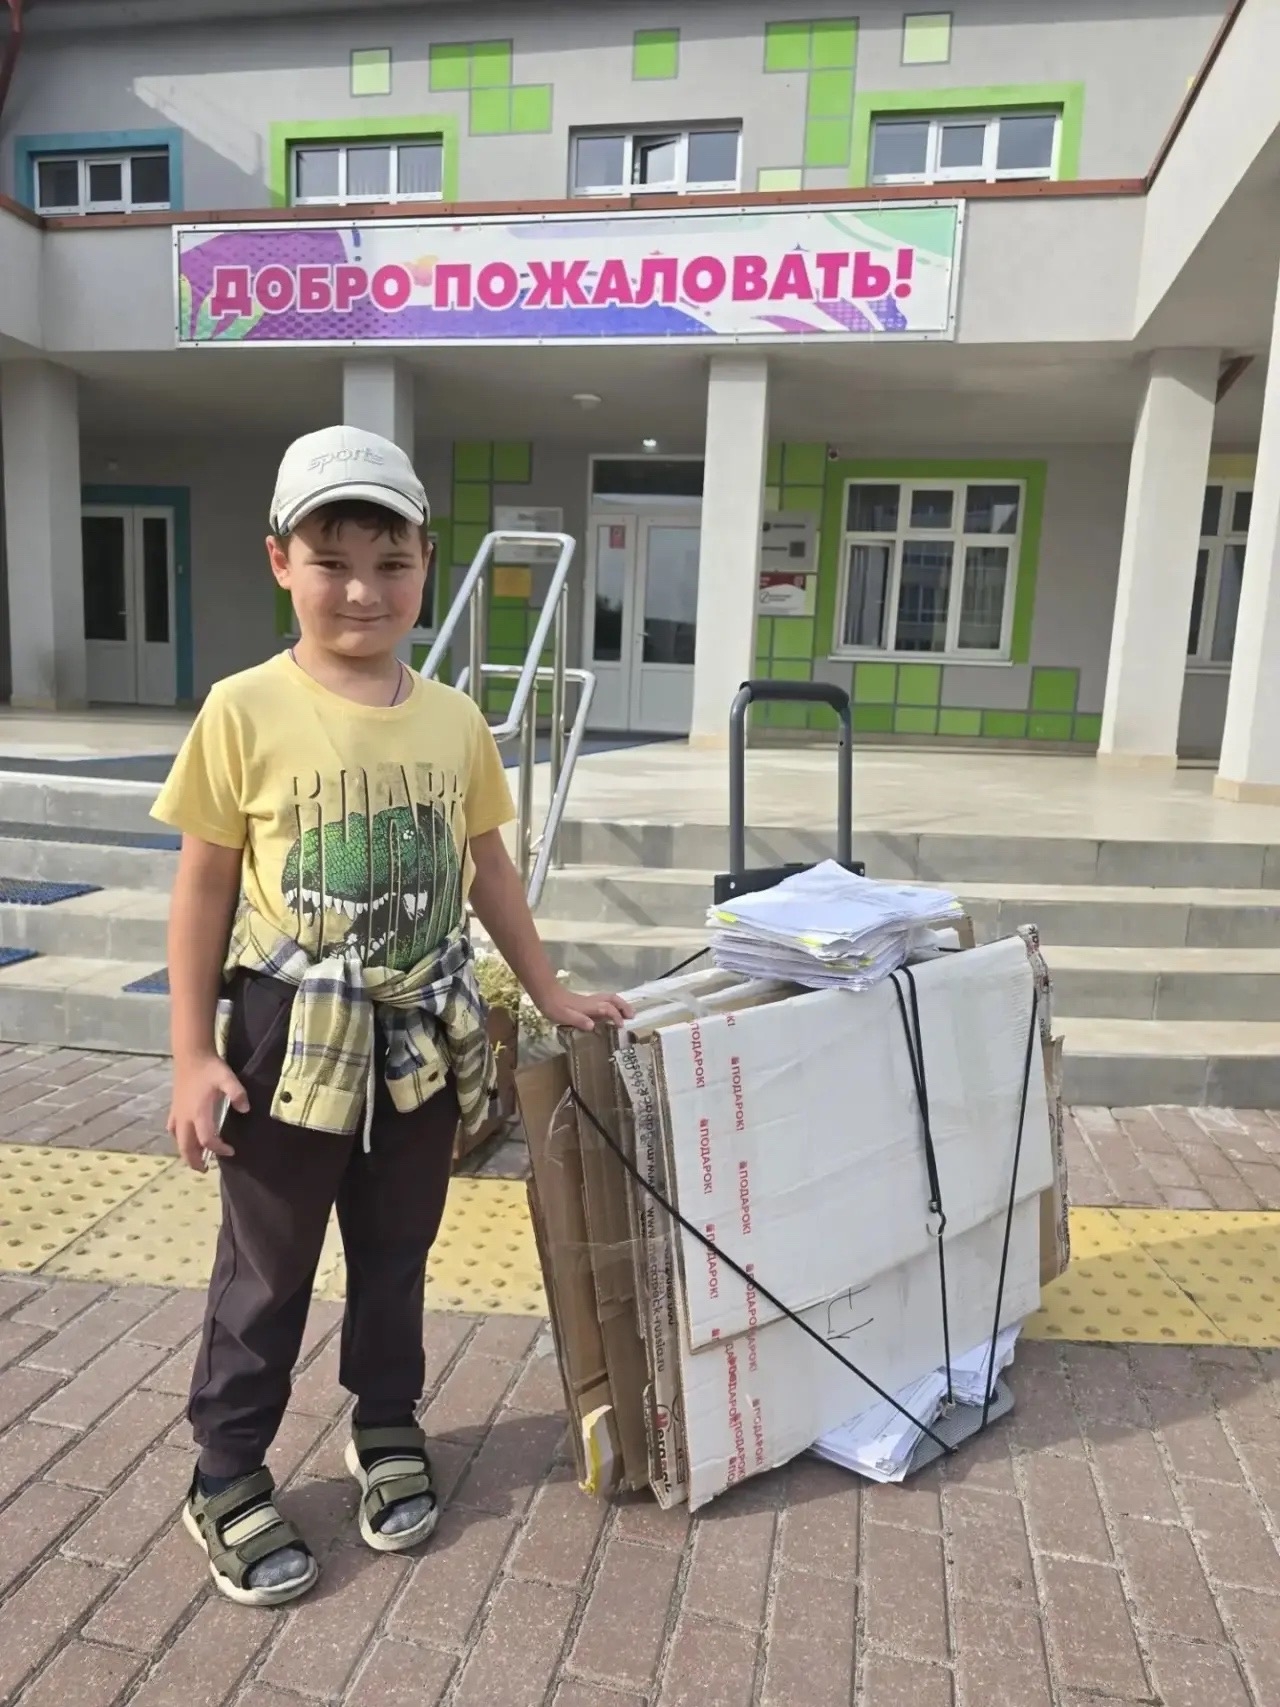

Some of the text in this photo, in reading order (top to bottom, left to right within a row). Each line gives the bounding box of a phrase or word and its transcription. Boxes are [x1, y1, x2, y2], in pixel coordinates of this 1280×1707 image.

[209, 248, 915, 319] ДОБРО ПОЖАЛОВАТЬ!
[307, 447, 385, 474] sports
[690, 1022, 705, 1089] ПОДАРОК!
[731, 1065, 745, 1132] ПОДАРОК!
[700, 1128, 713, 1195] ПОДАРОК!
[739, 1170, 752, 1236] ПОДАРОК!
[706, 1232, 719, 1300] ПДАРОК!
